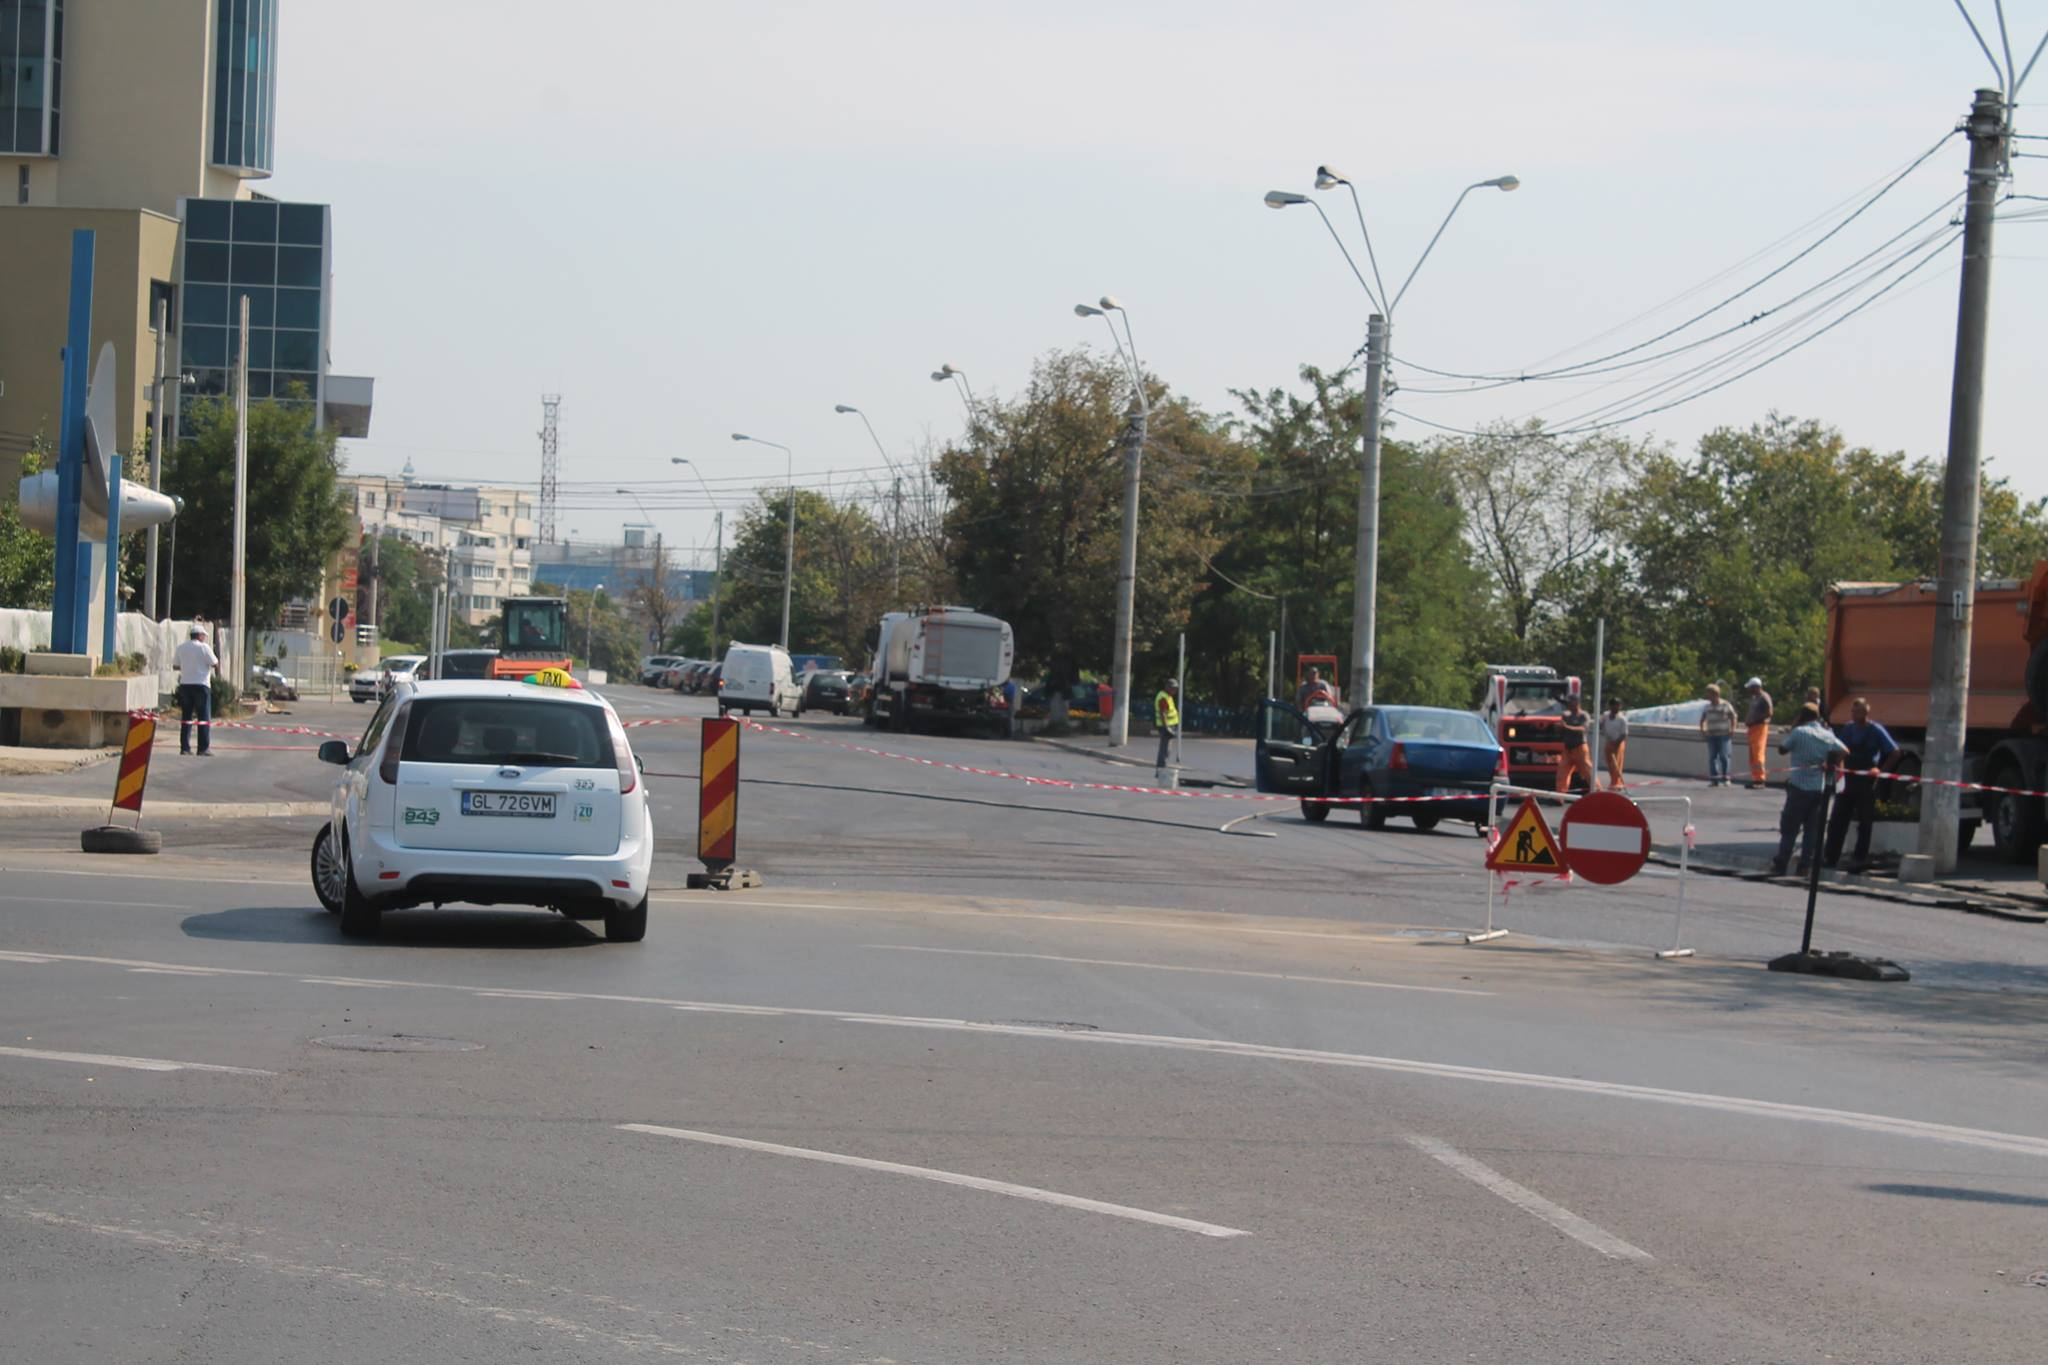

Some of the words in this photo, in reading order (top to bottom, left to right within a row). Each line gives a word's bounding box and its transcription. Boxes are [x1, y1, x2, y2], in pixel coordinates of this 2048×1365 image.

[543, 671, 562, 688] TAXI
[472, 794, 492, 809] GL
[499, 795, 552, 812] 72GVM
[404, 811, 441, 822] 943
